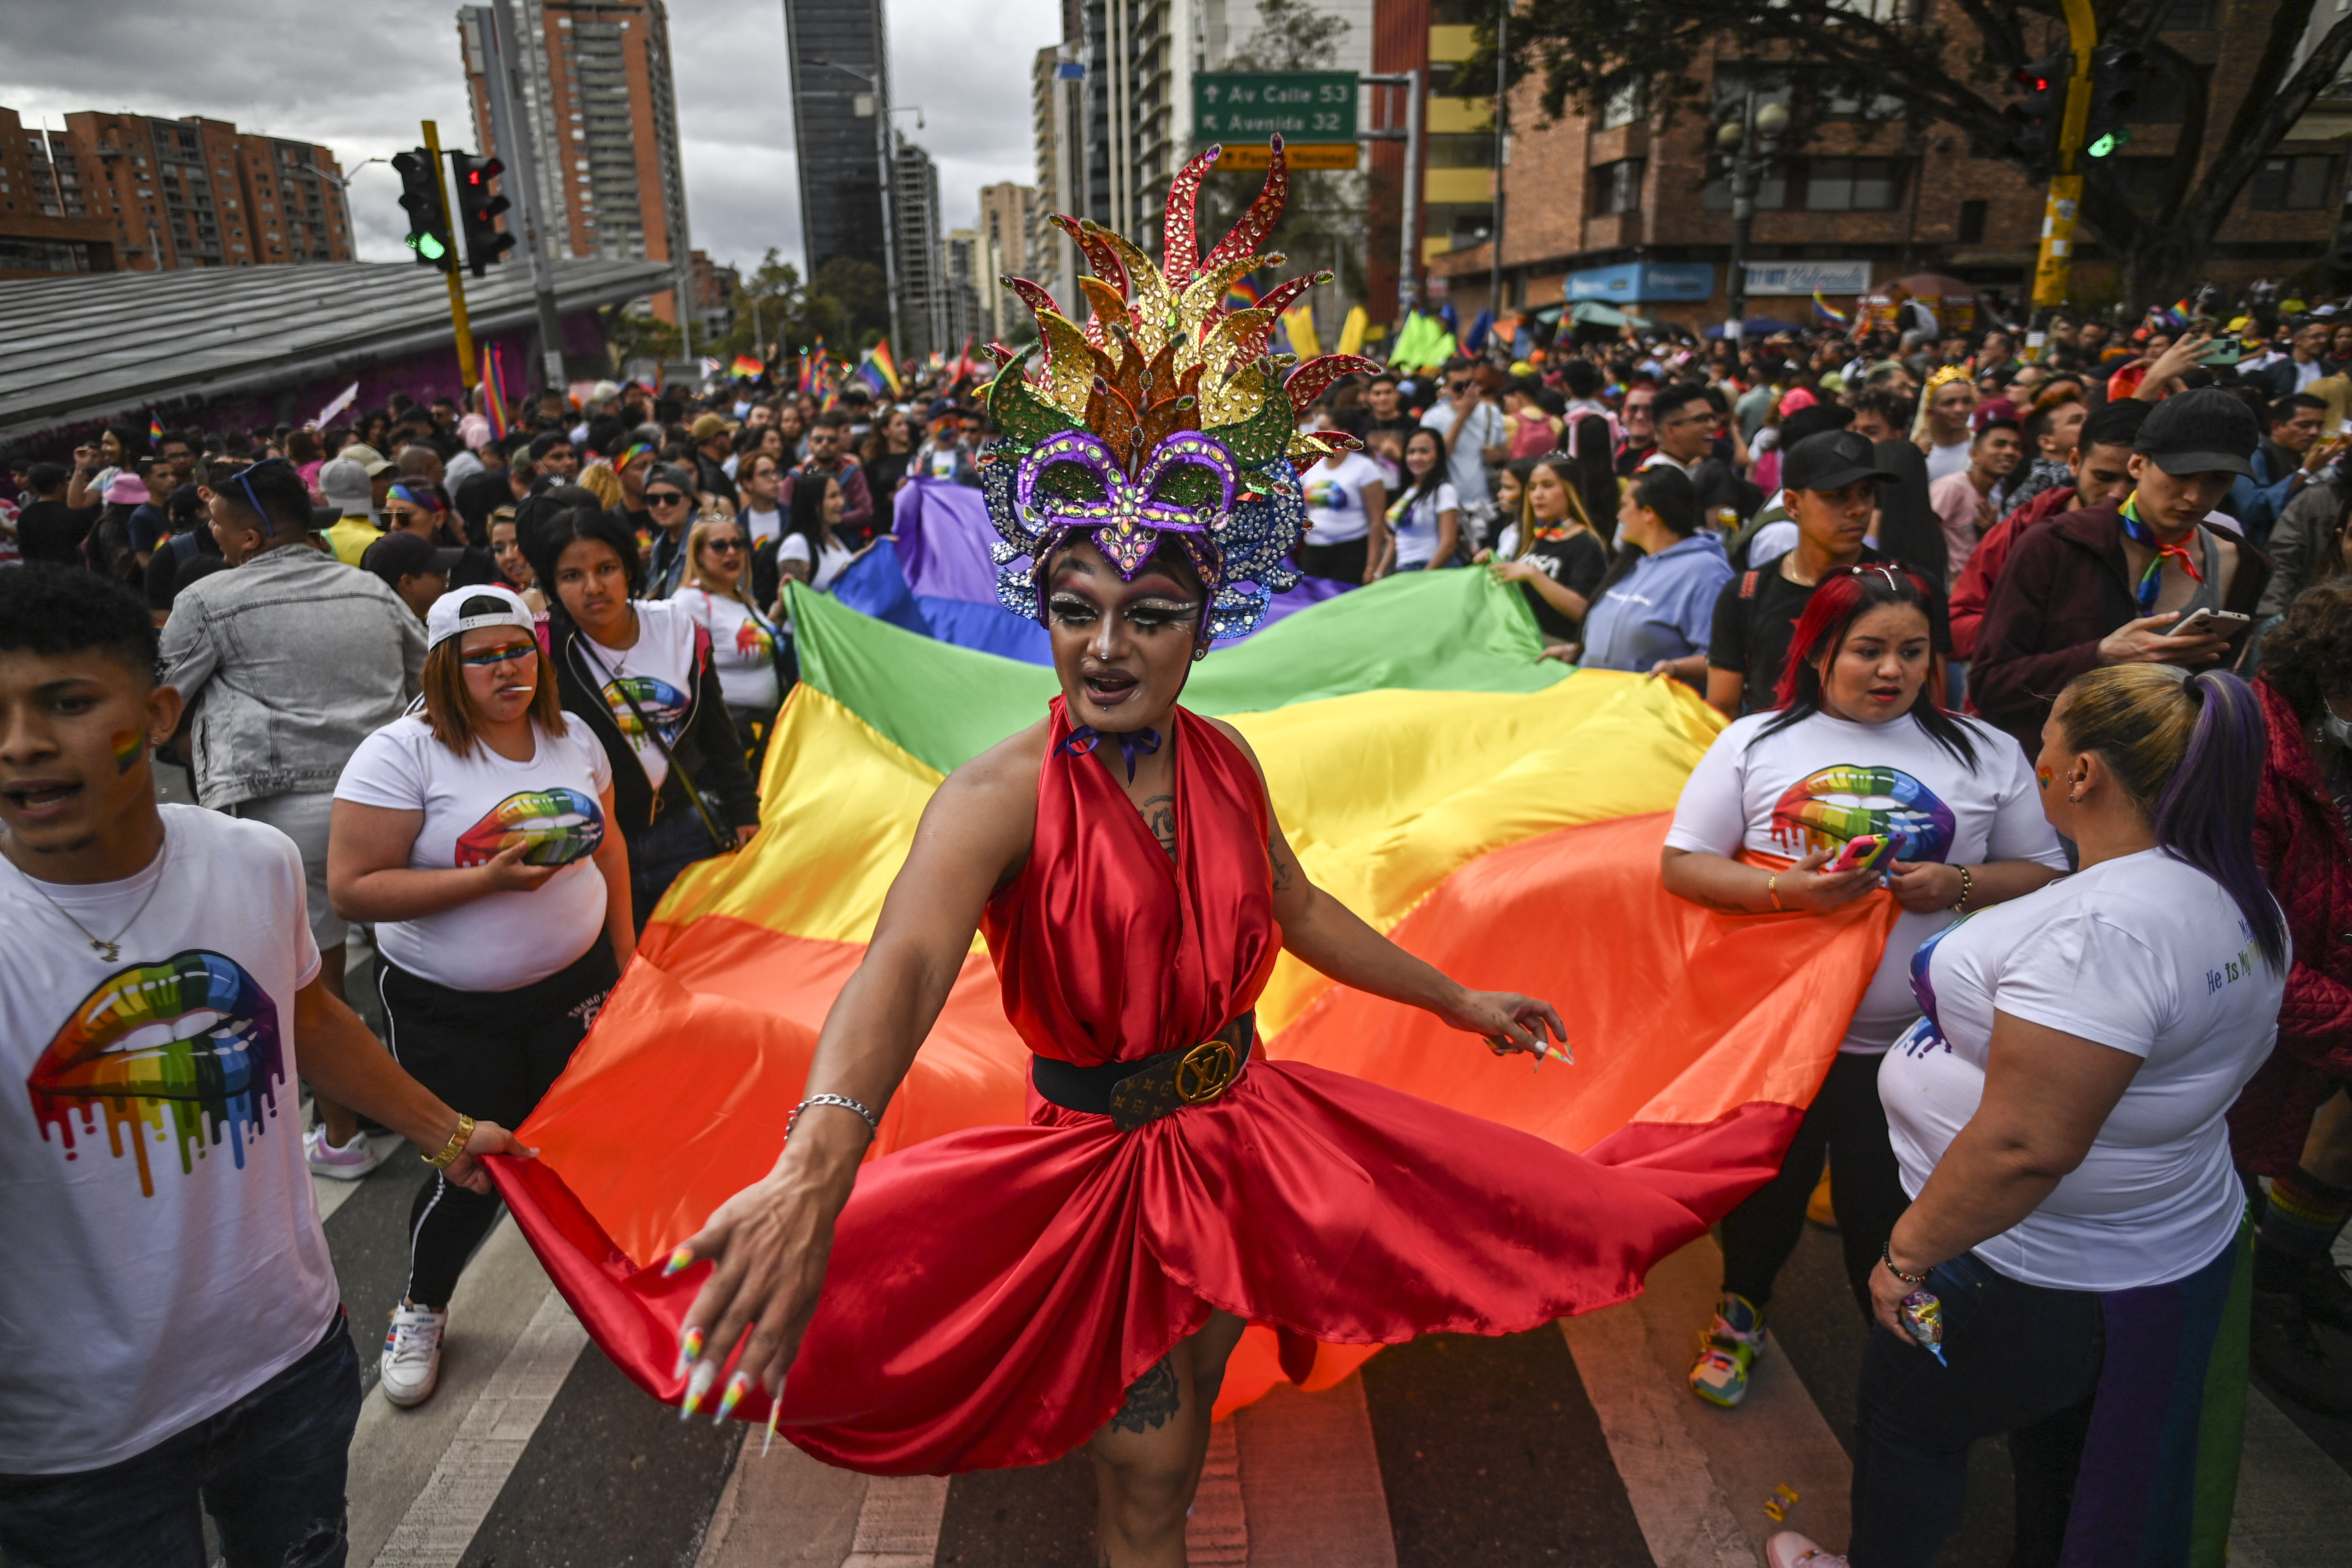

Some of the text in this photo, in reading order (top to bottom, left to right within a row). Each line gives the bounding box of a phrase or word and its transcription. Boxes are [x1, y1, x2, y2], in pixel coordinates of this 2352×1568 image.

[1228, 84, 1348, 103] Av Calle 53
[1228, 113, 1341, 131] Avenida 32
[2206, 969, 2222, 996] He
[2238, 950, 2251, 976] My
